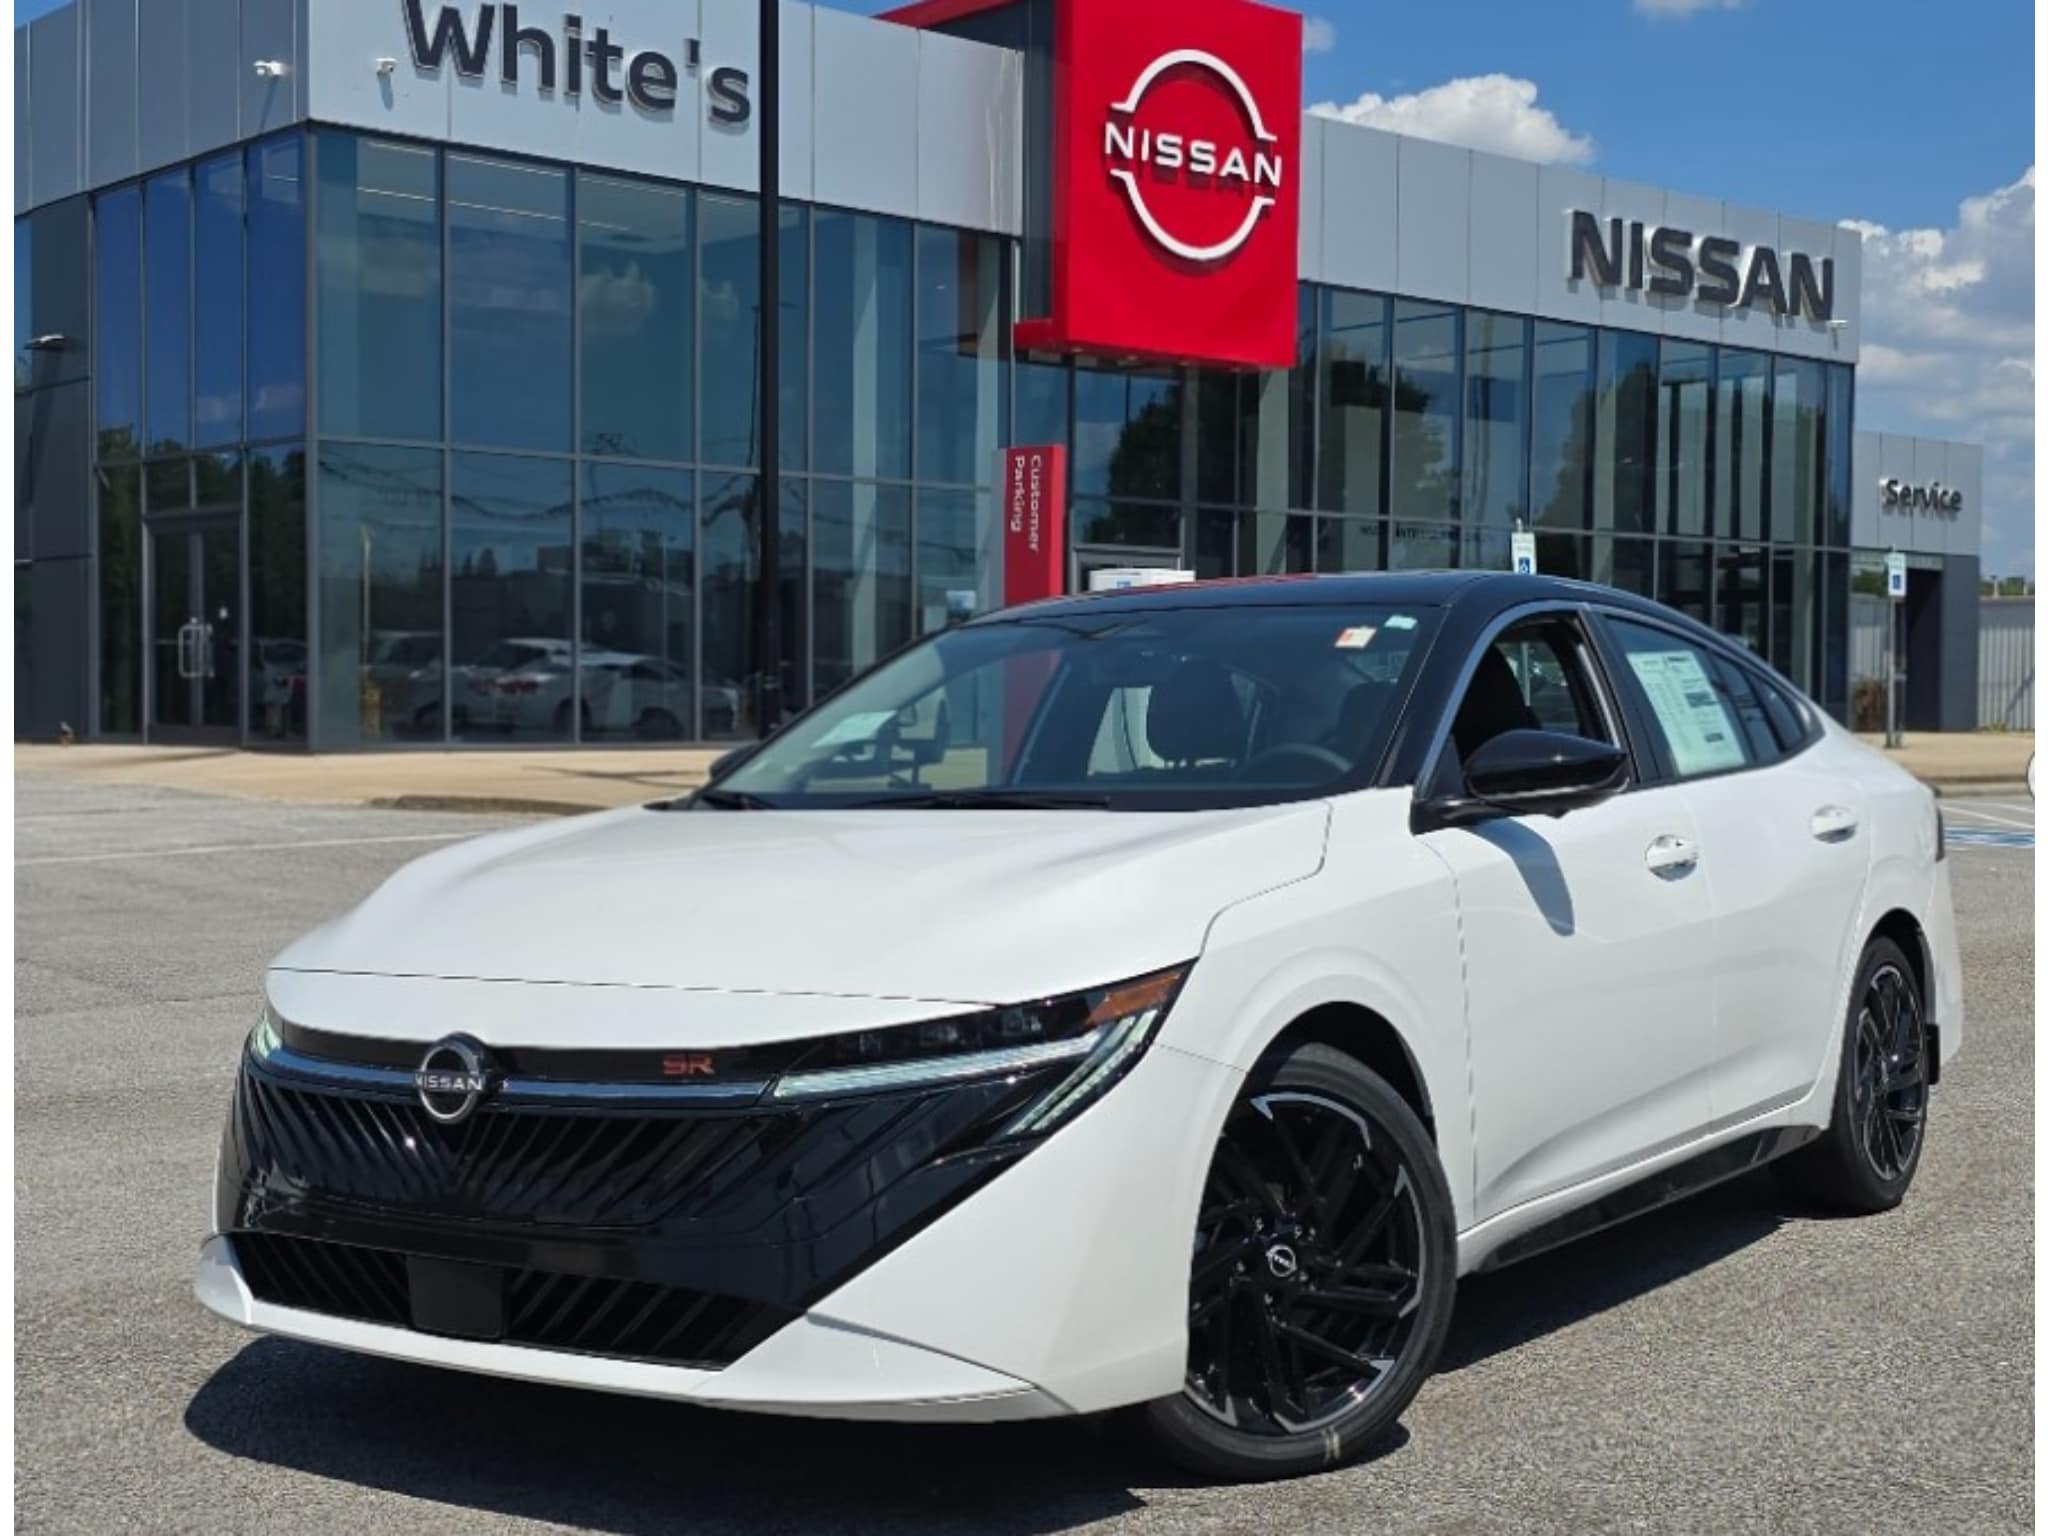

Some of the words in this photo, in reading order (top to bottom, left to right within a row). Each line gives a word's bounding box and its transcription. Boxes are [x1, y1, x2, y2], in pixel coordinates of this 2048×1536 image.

[402, 0, 751, 122] White's
[1104, 121, 1282, 187] NISSAN
[1571, 210, 1834, 321] NISSAN
[1011, 455, 1025, 531] Parking
[1029, 455, 1041, 552] Customer
[1886, 480, 1963, 512] Service
[413, 1070, 484, 1092] NISSAN
[663, 1055, 715, 1076] SR
